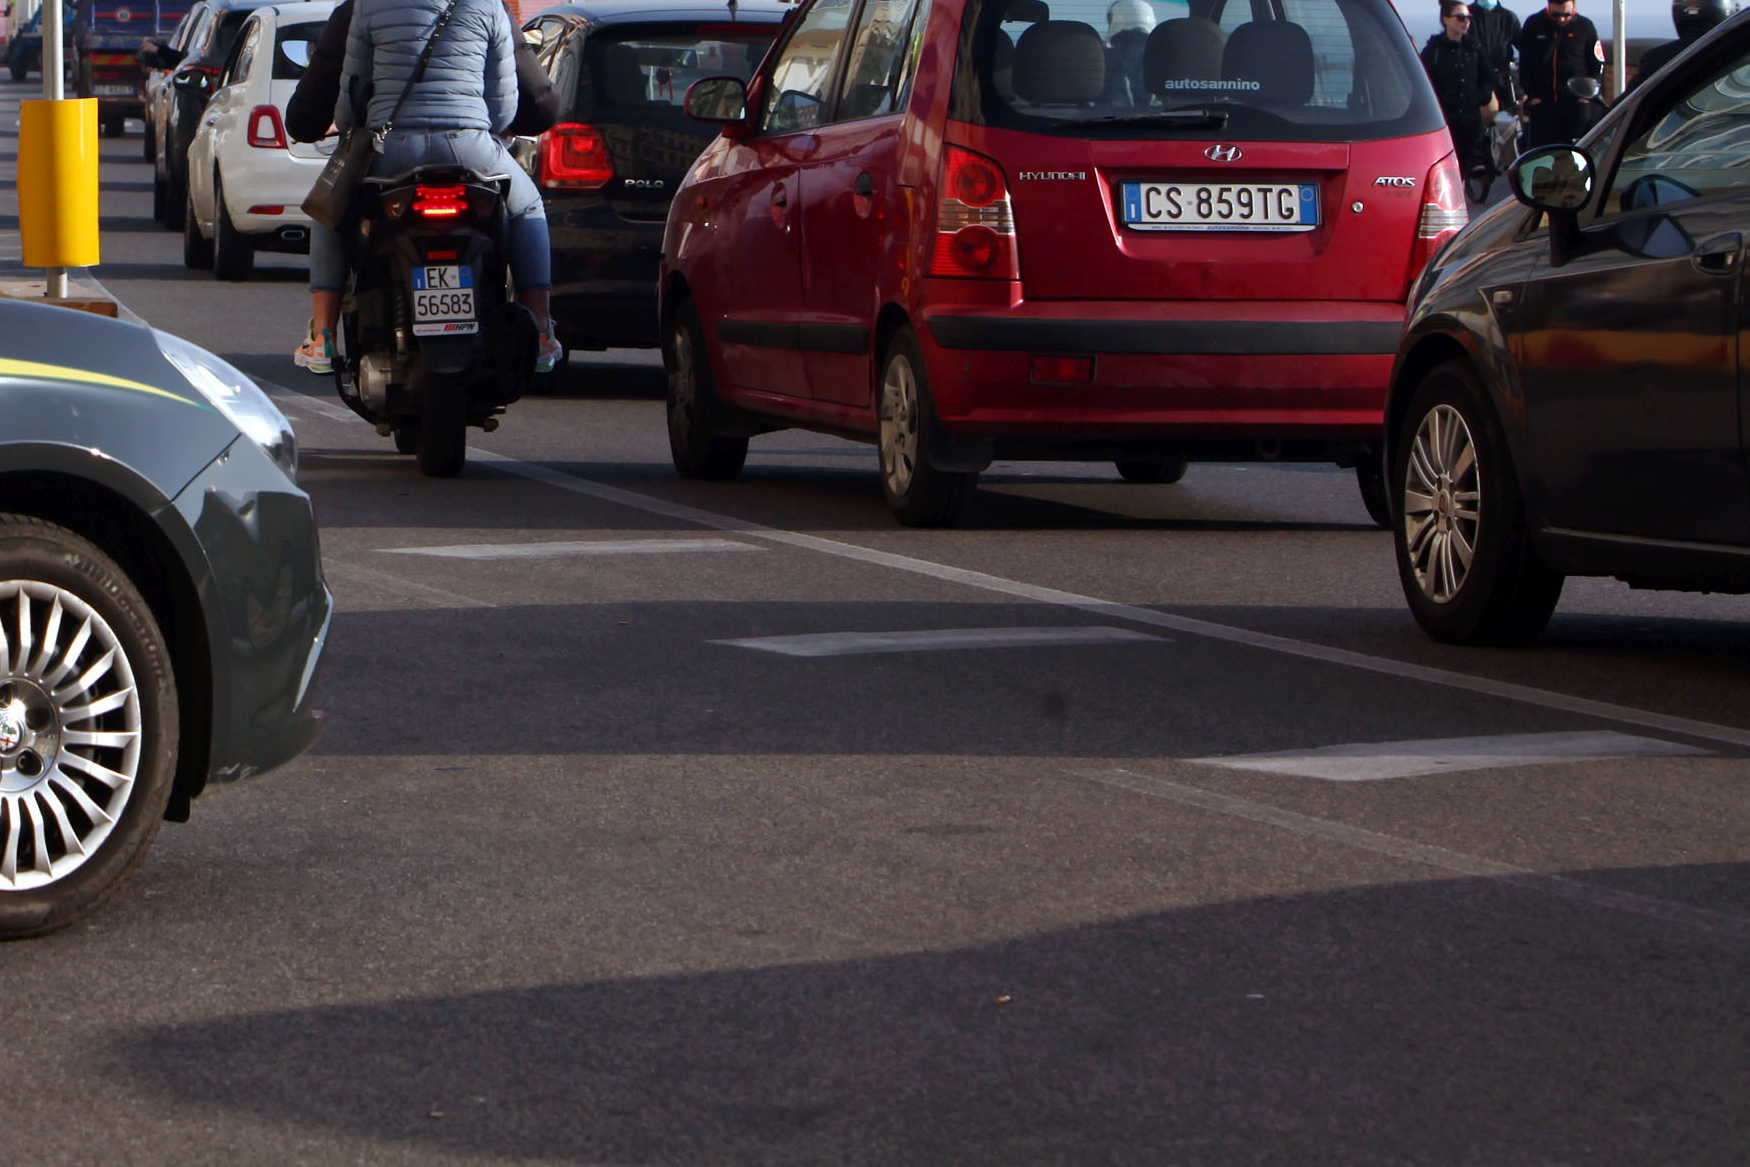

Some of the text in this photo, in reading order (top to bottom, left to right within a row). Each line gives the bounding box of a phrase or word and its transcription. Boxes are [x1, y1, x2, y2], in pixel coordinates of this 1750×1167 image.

[1165, 78, 1260, 90] autosannino
[1019, 171, 1086, 180] HYUNDAI
[1372, 176, 1417, 186] ATOS
[624, 179, 664, 188] POLO
[1145, 186, 1183, 219] CS
[1196, 187, 1295, 220] 859TG
[426, 267, 449, 288] EK
[417, 294, 472, 316] 56583
